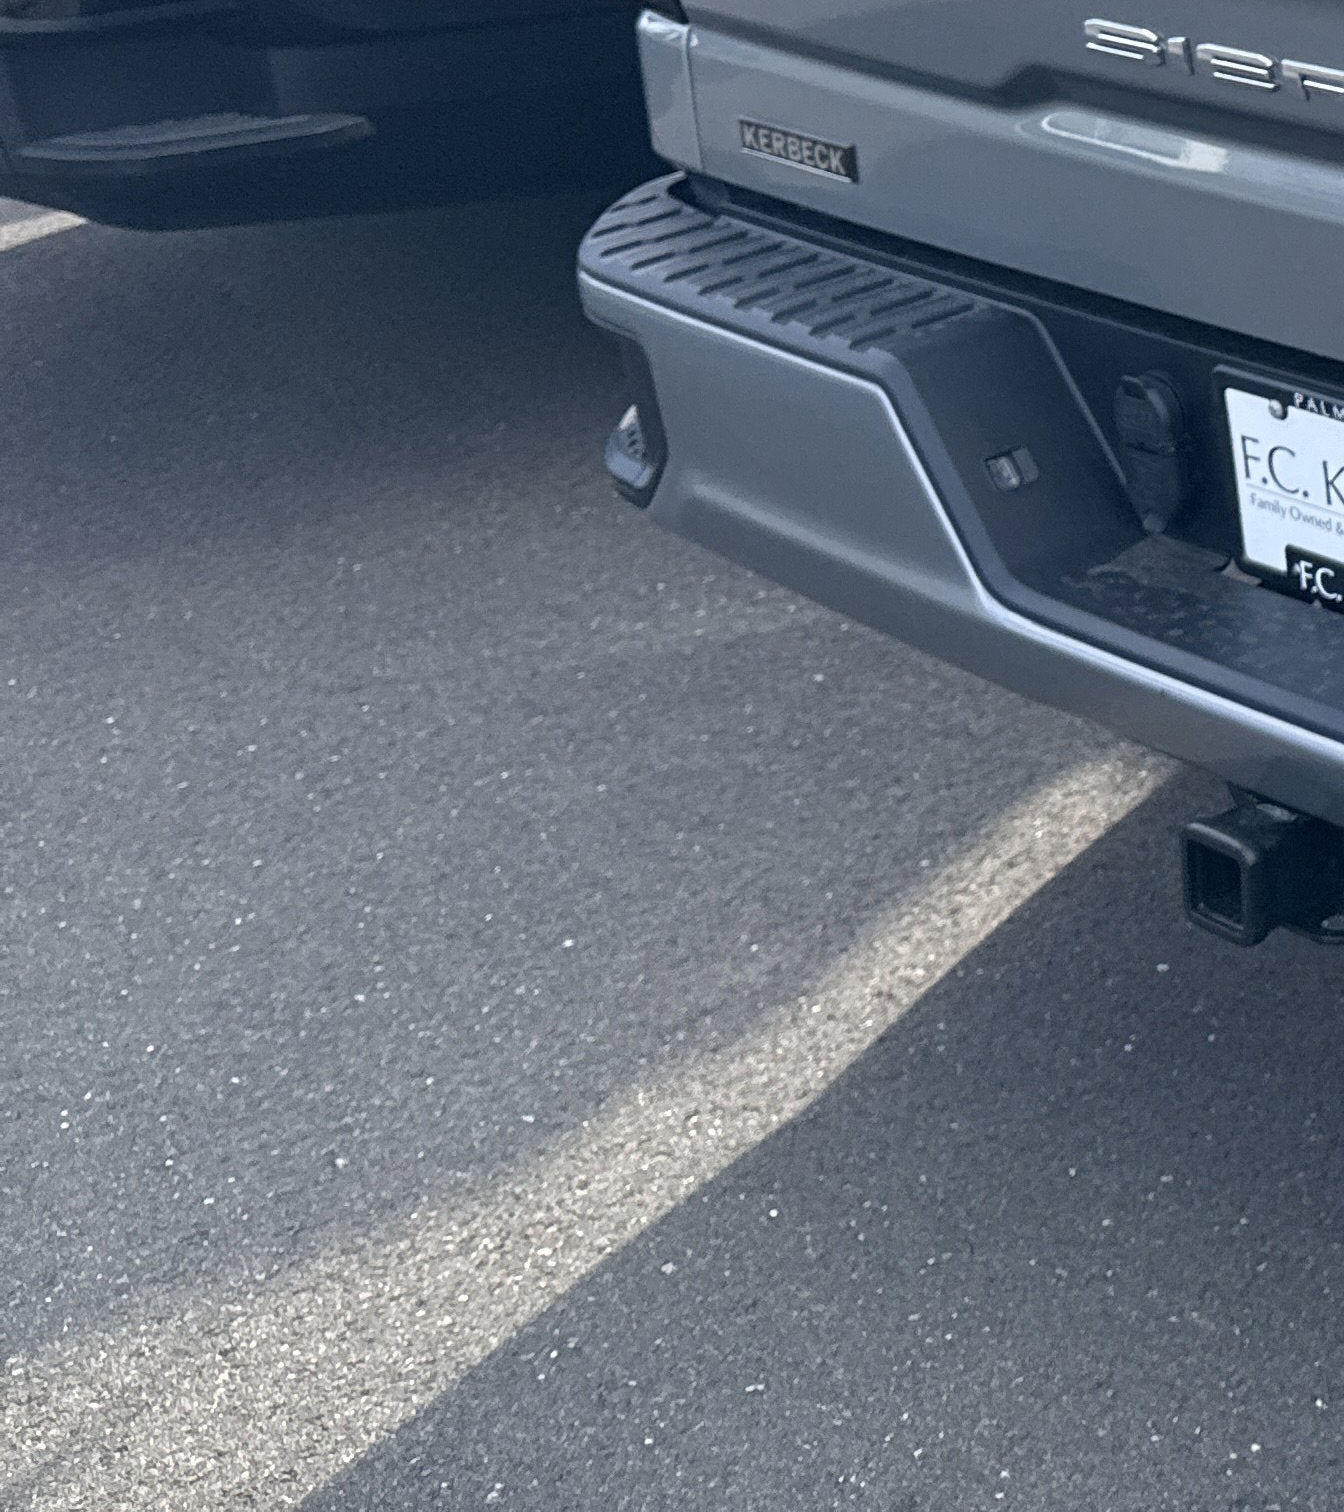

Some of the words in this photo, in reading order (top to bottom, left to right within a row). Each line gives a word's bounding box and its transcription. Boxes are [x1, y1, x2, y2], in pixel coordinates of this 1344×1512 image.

[743, 125, 846, 175] KERBECK
[1240, 435, 1310, 499] F.C.
[1249, 493, 1287, 519] Family
[1289, 505, 1332, 532] Owned
[1335, 522, 1344, 536] &
[1298, 560, 1344, 602] F.C.
